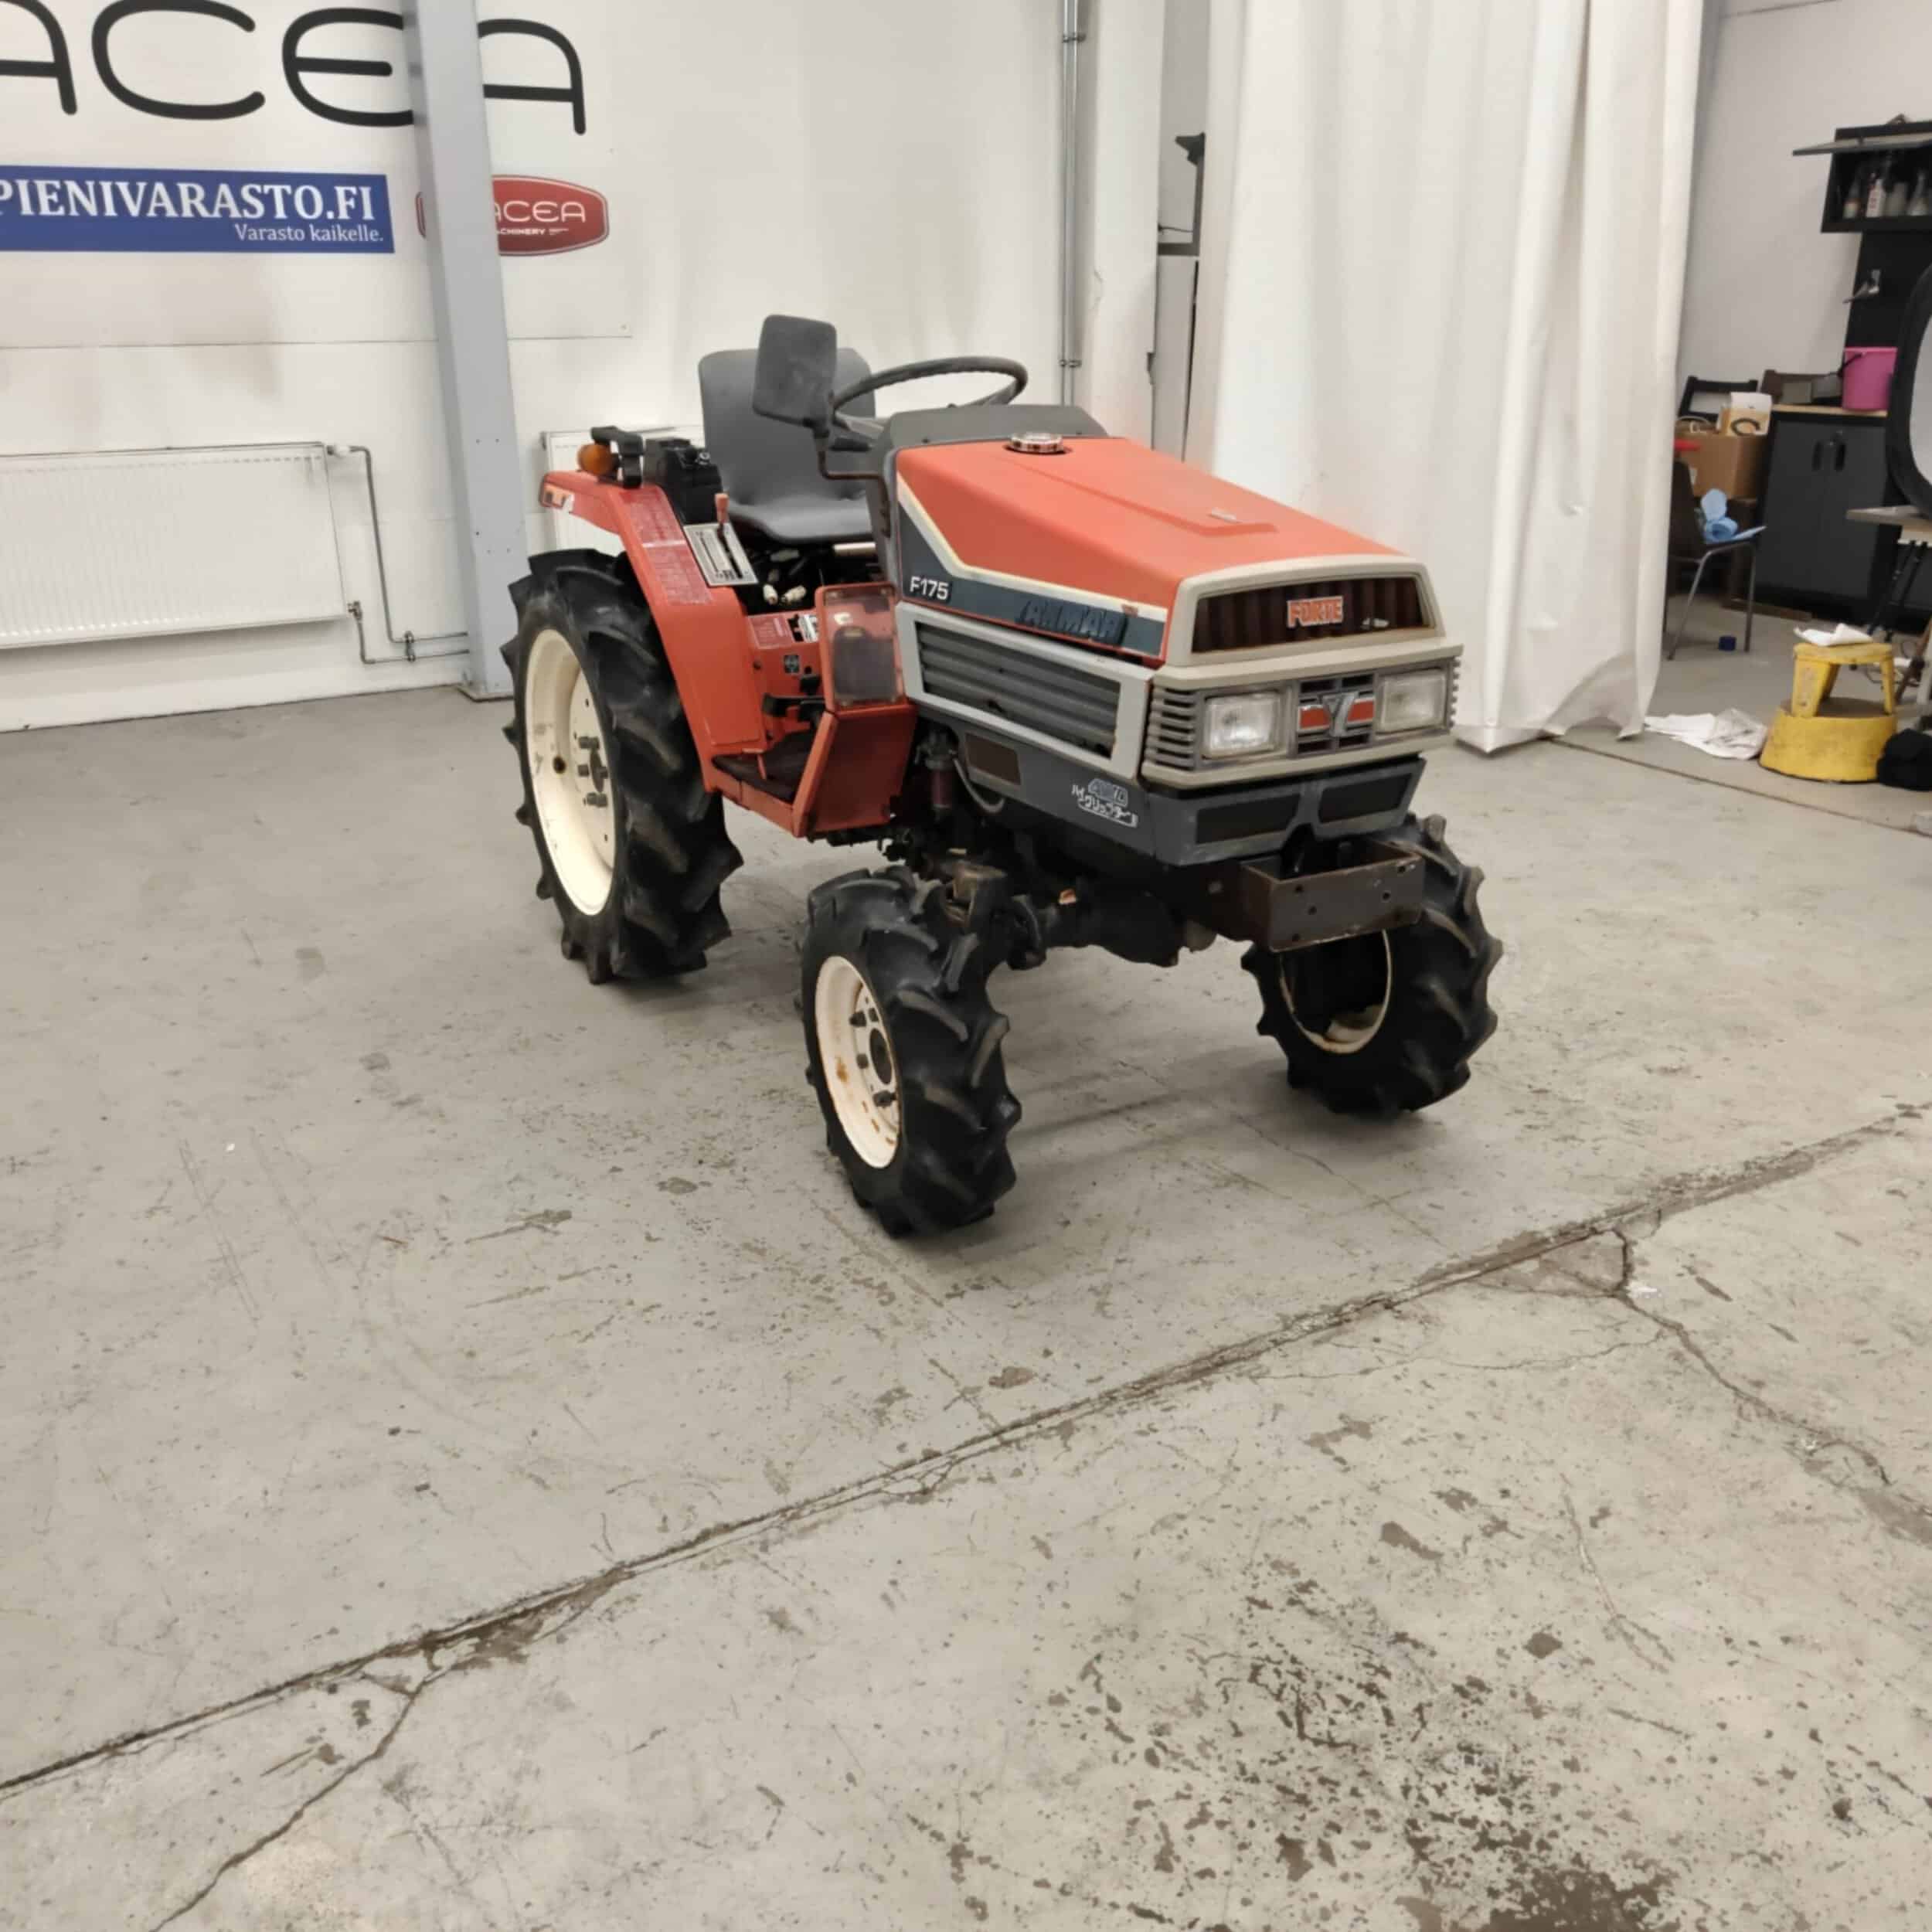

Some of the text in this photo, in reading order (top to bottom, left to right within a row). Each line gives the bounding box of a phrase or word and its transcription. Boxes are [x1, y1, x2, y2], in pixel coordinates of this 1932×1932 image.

[494, 200, 586, 223] CEA
[235, 223, 384, 242] Varasto kaikelle.
[909, 576, 950, 600] F175
